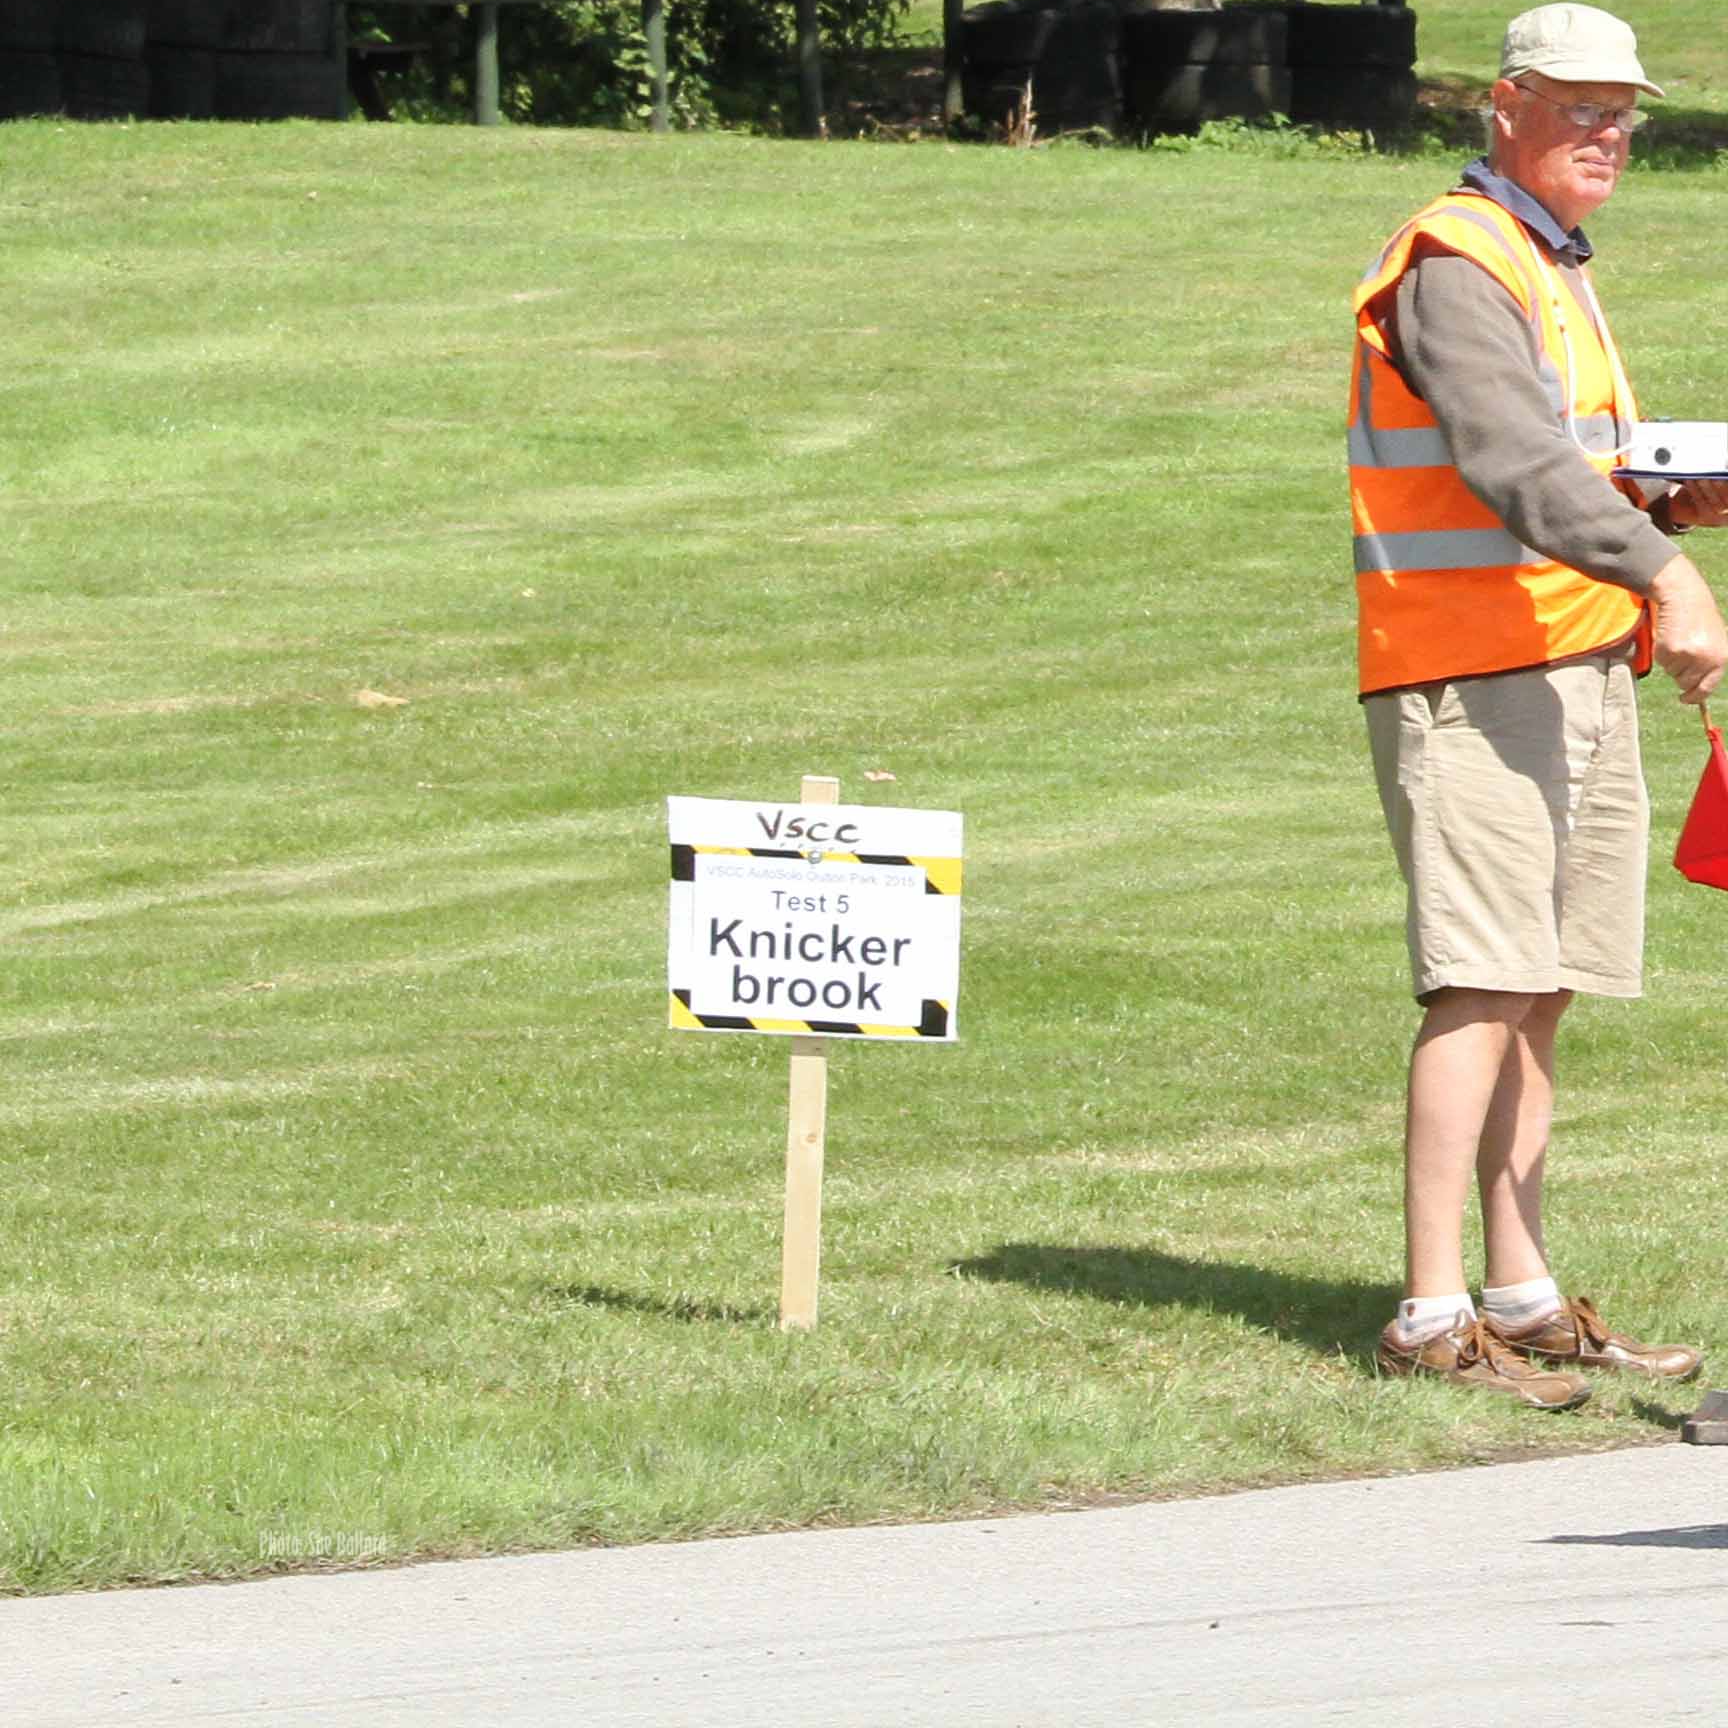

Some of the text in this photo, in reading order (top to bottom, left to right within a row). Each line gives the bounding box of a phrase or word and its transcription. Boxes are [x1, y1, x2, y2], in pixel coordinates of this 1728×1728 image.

[771, 890, 850, 915] Test 5
[709, 917, 912, 967] Knicker
[732, 964, 882, 1011] brook
